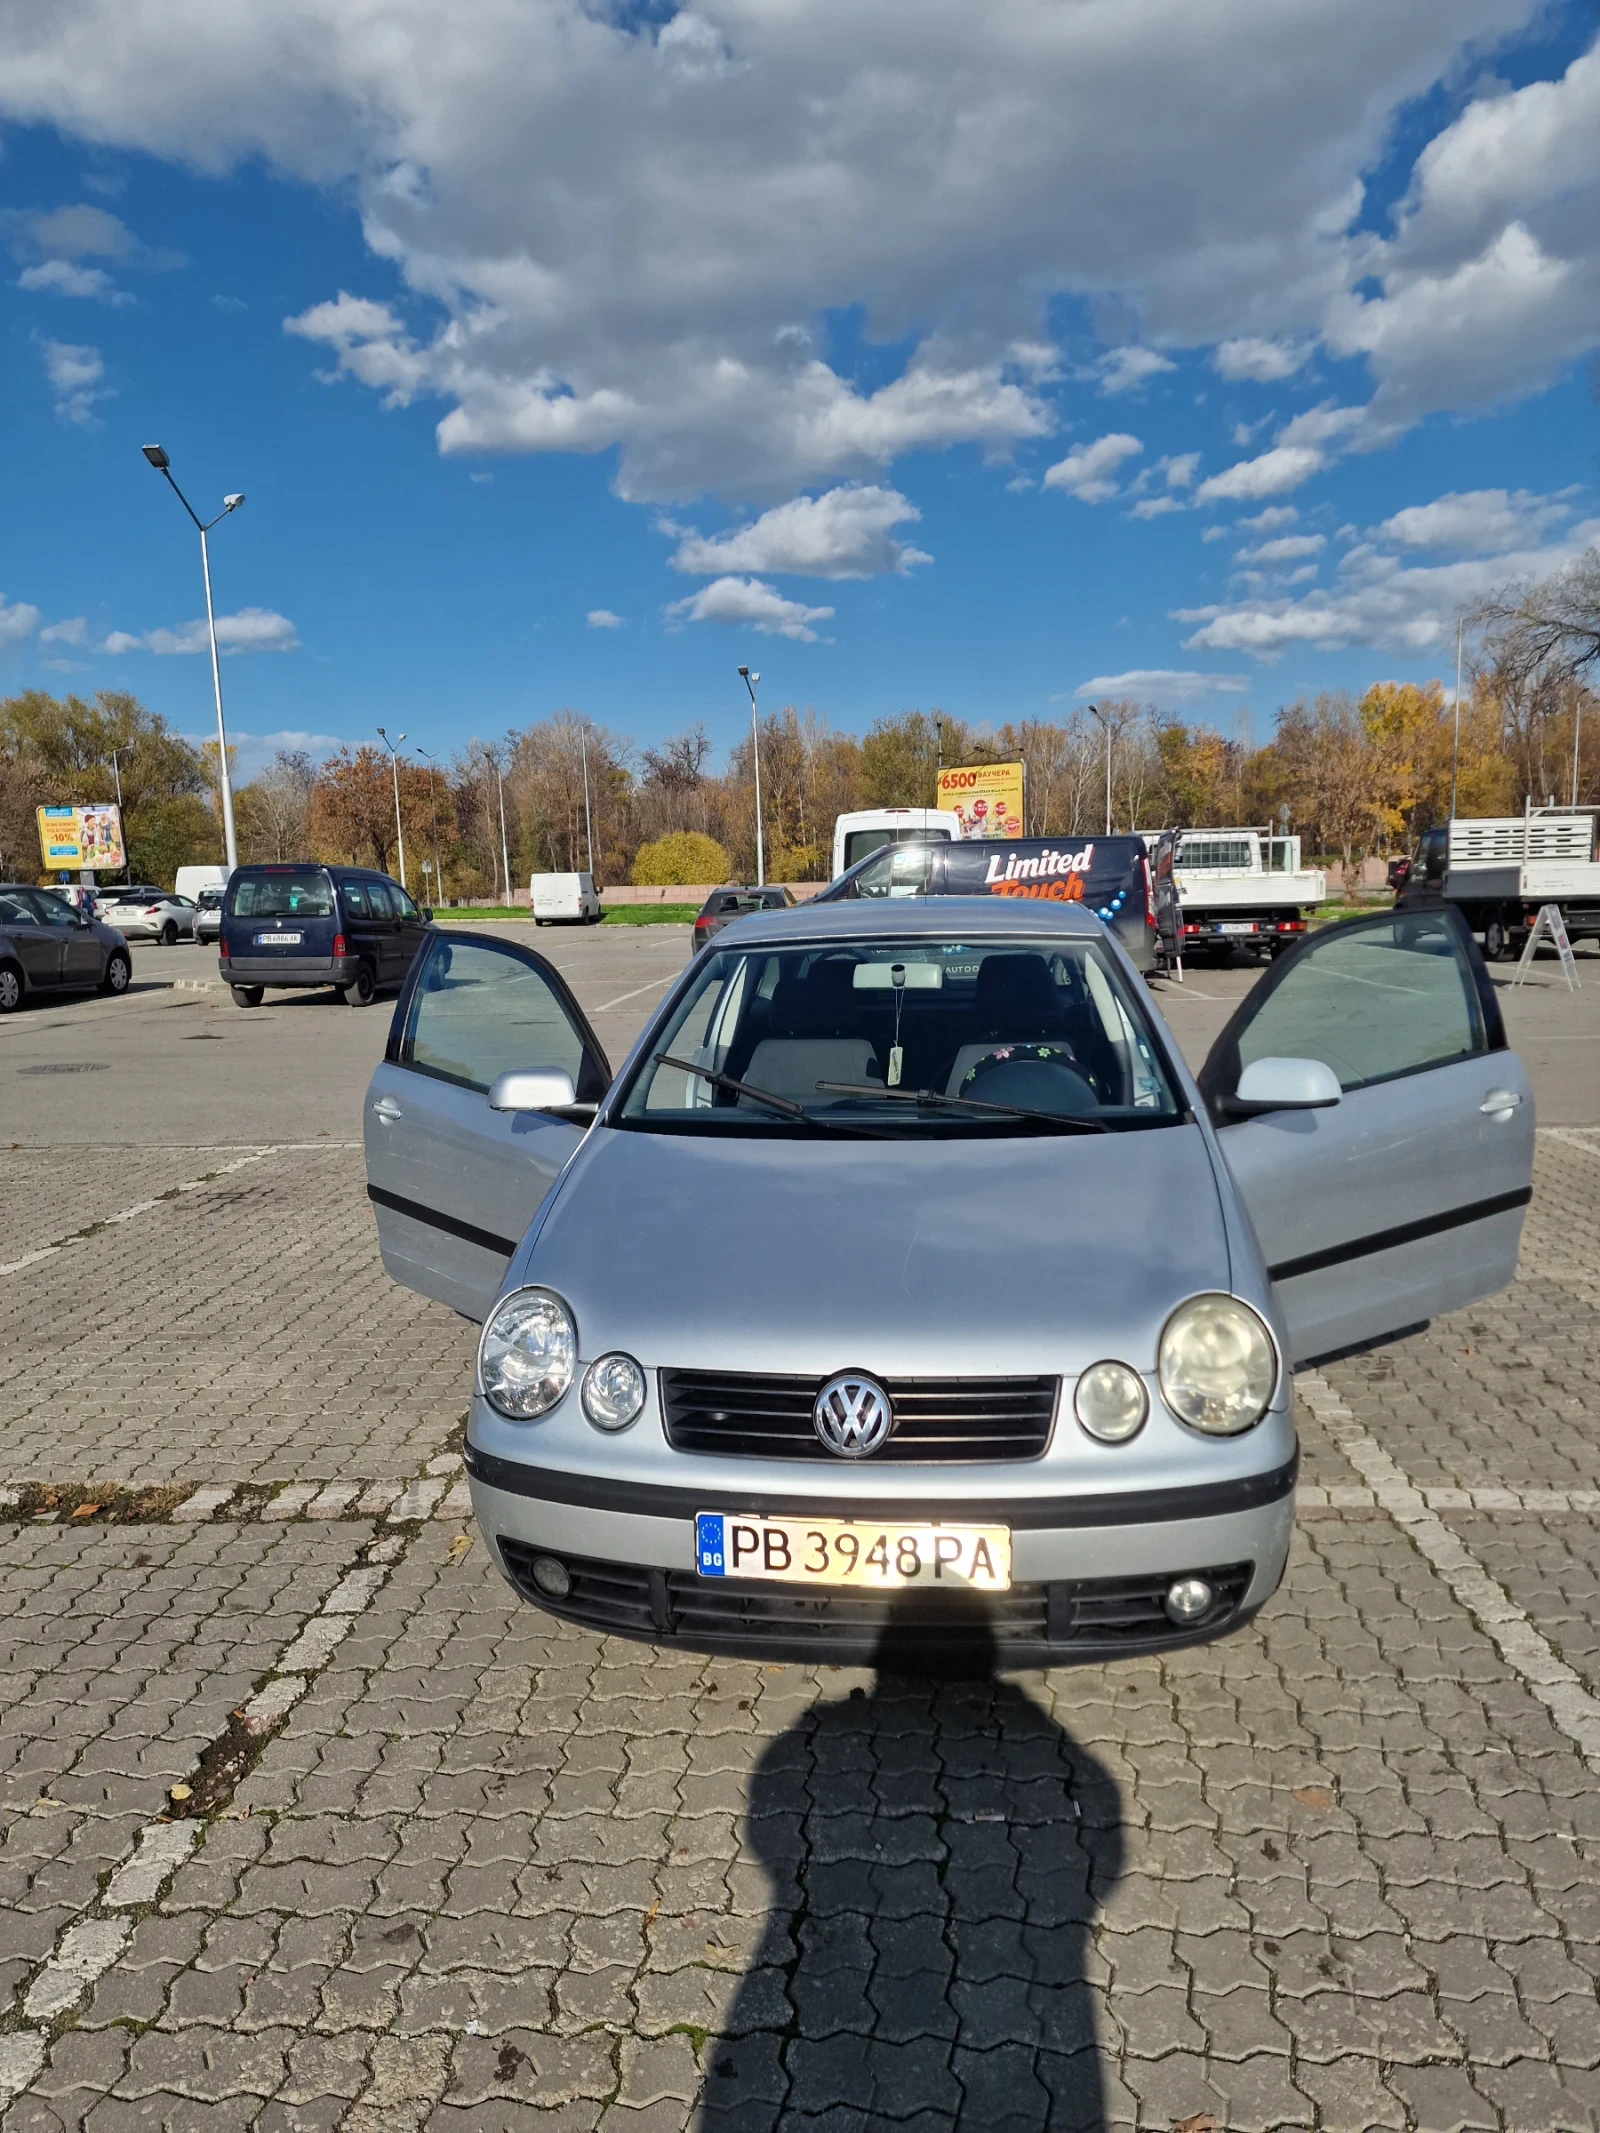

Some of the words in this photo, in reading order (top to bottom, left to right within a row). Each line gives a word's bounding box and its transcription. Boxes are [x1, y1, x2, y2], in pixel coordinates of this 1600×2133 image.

[942, 772, 976, 789] 6500
[978, 769, 1010, 778] ВАУЧЕРА
[51, 833, 74, 842] -10%
[984, 843, 1095, 883] Limited
[991, 872, 1084, 900] Touch
[702, 1551, 723, 1567] BG
[731, 1525, 792, 1571] PB
[804, 1531, 922, 1577] 3948
[934, 1536, 996, 1579] PA
